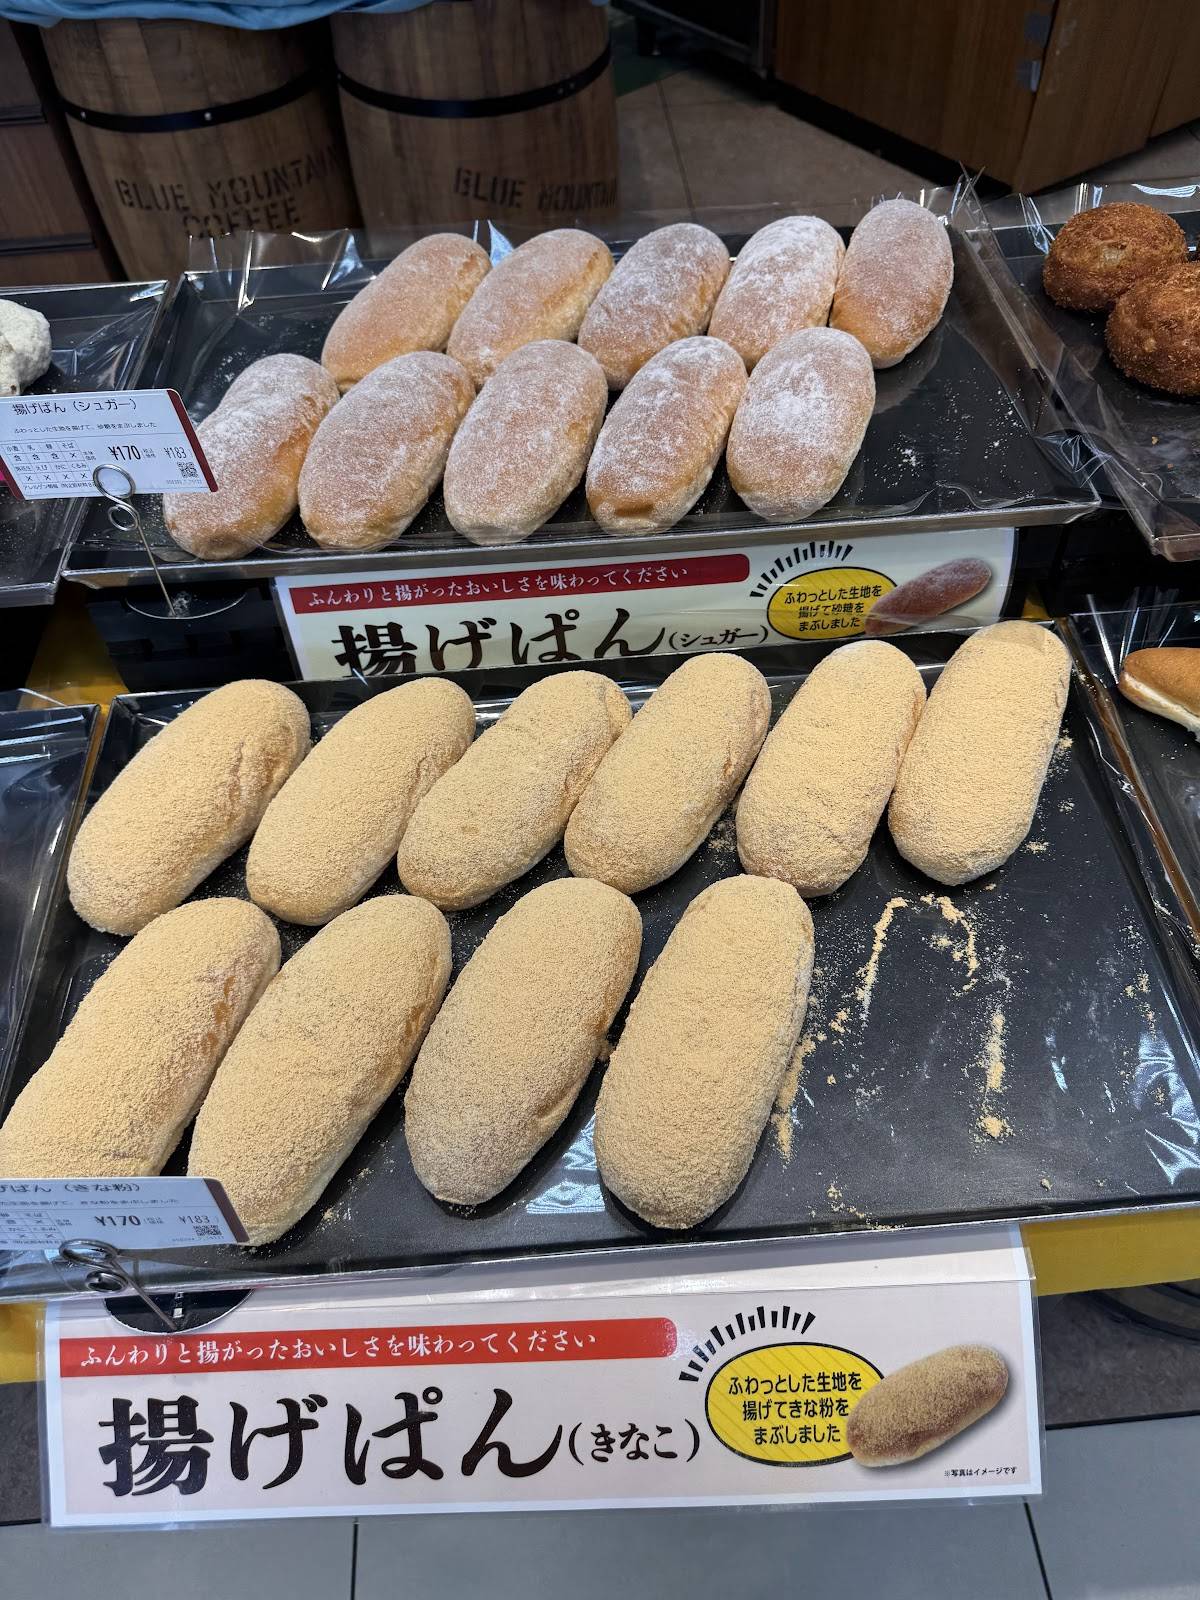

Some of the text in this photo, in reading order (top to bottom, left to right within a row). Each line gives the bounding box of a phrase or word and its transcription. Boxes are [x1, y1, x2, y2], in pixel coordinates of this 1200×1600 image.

[115, 178, 190, 212] BLUE
[453, 167, 527, 209] BLUE
[183, 197, 301, 238] COFFEE
[108, 445, 141, 461] ¥170
[164, 446, 187, 460] ¥183
[308, 566, 689, 607] ふんわりと揚がったおいしさを味わってください
[784, 584, 883, 604] ふわっとした生地を
[797, 602, 864, 619] 揚げて砂糖を
[798, 618, 861, 632] まぶしました
[95, 1215, 141, 1226] ¥170
[178, 1215, 210, 1225] ¥183
[80, 1328, 597, 1366] ふんわりと揚がったおいしさを味わってください
[728, 1371, 863, 1396] ふわっとした生地を
[742, 1397, 849, 1421] 揚げてきな粉を
[754, 1423, 841, 1445] まぶしました
[944, 1466, 1018, 1478] ※写真はイメージです
